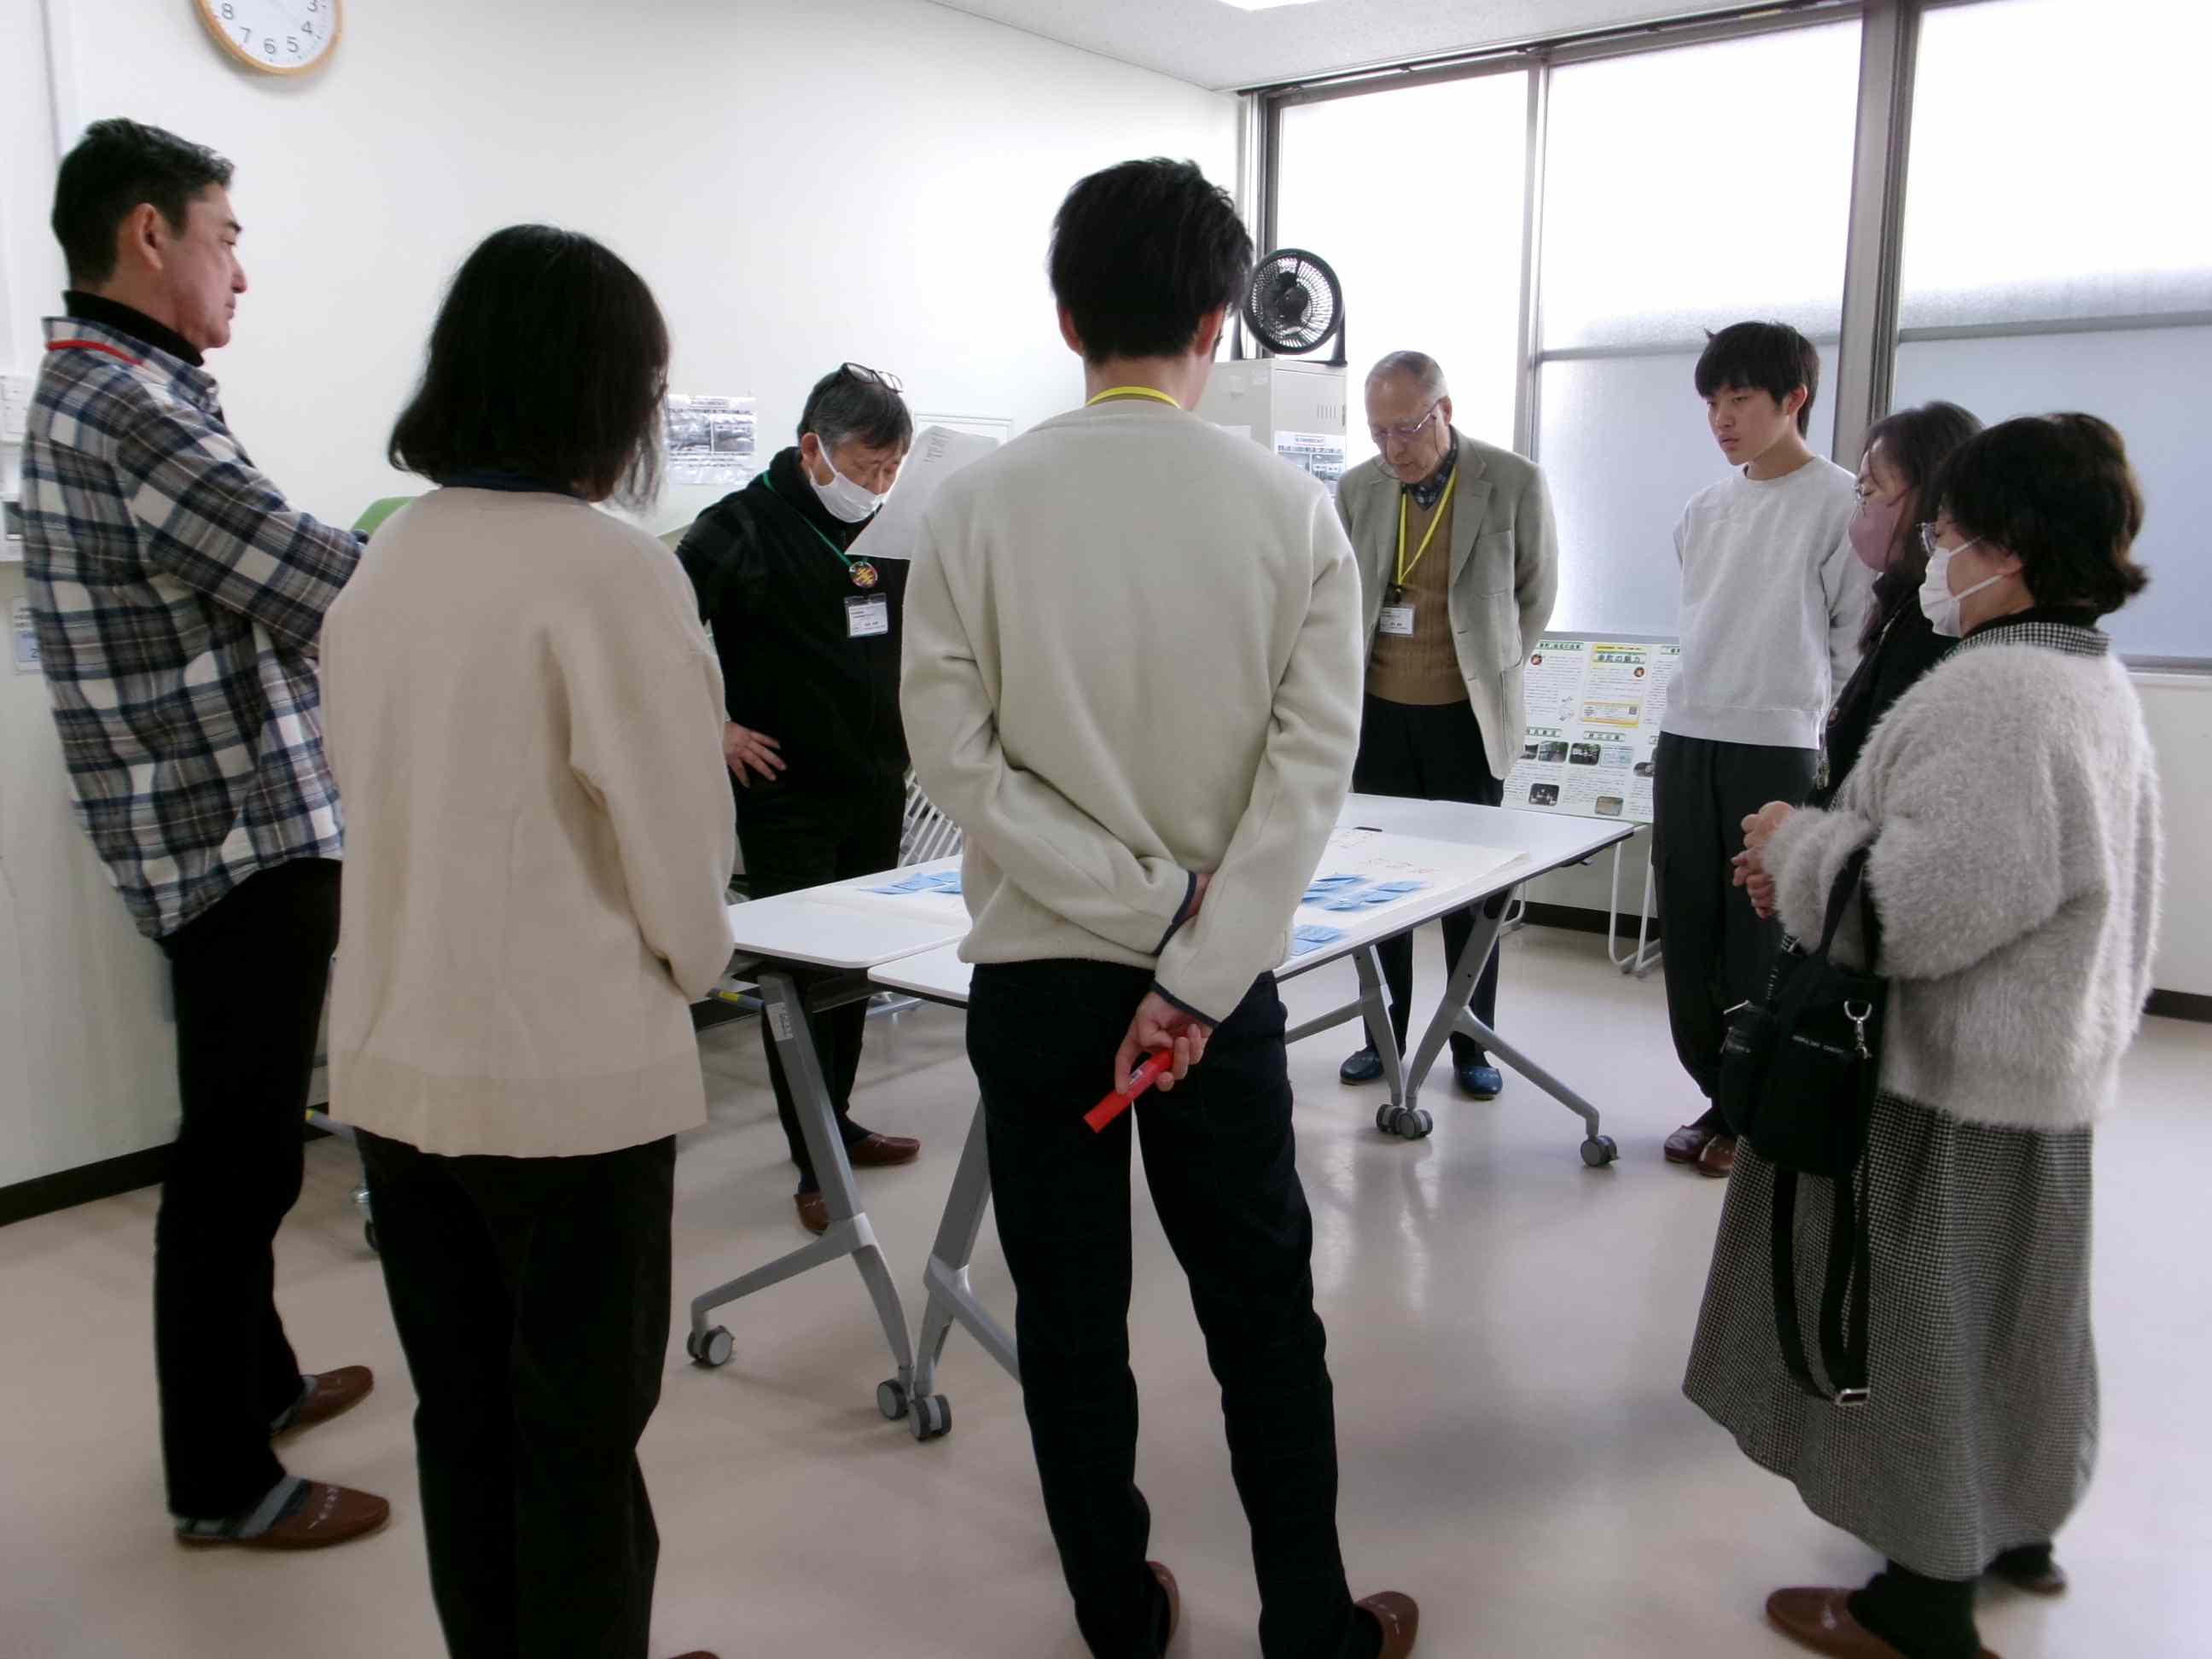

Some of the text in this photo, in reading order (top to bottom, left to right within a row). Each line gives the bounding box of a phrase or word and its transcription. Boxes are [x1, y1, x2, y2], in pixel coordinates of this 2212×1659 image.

[221, 3, 234, 20] 8
[240, 26, 252, 43] 7
[300, 20, 313, 34] 4
[264, 38, 276, 55] 6
[286, 36, 299, 53] 5
